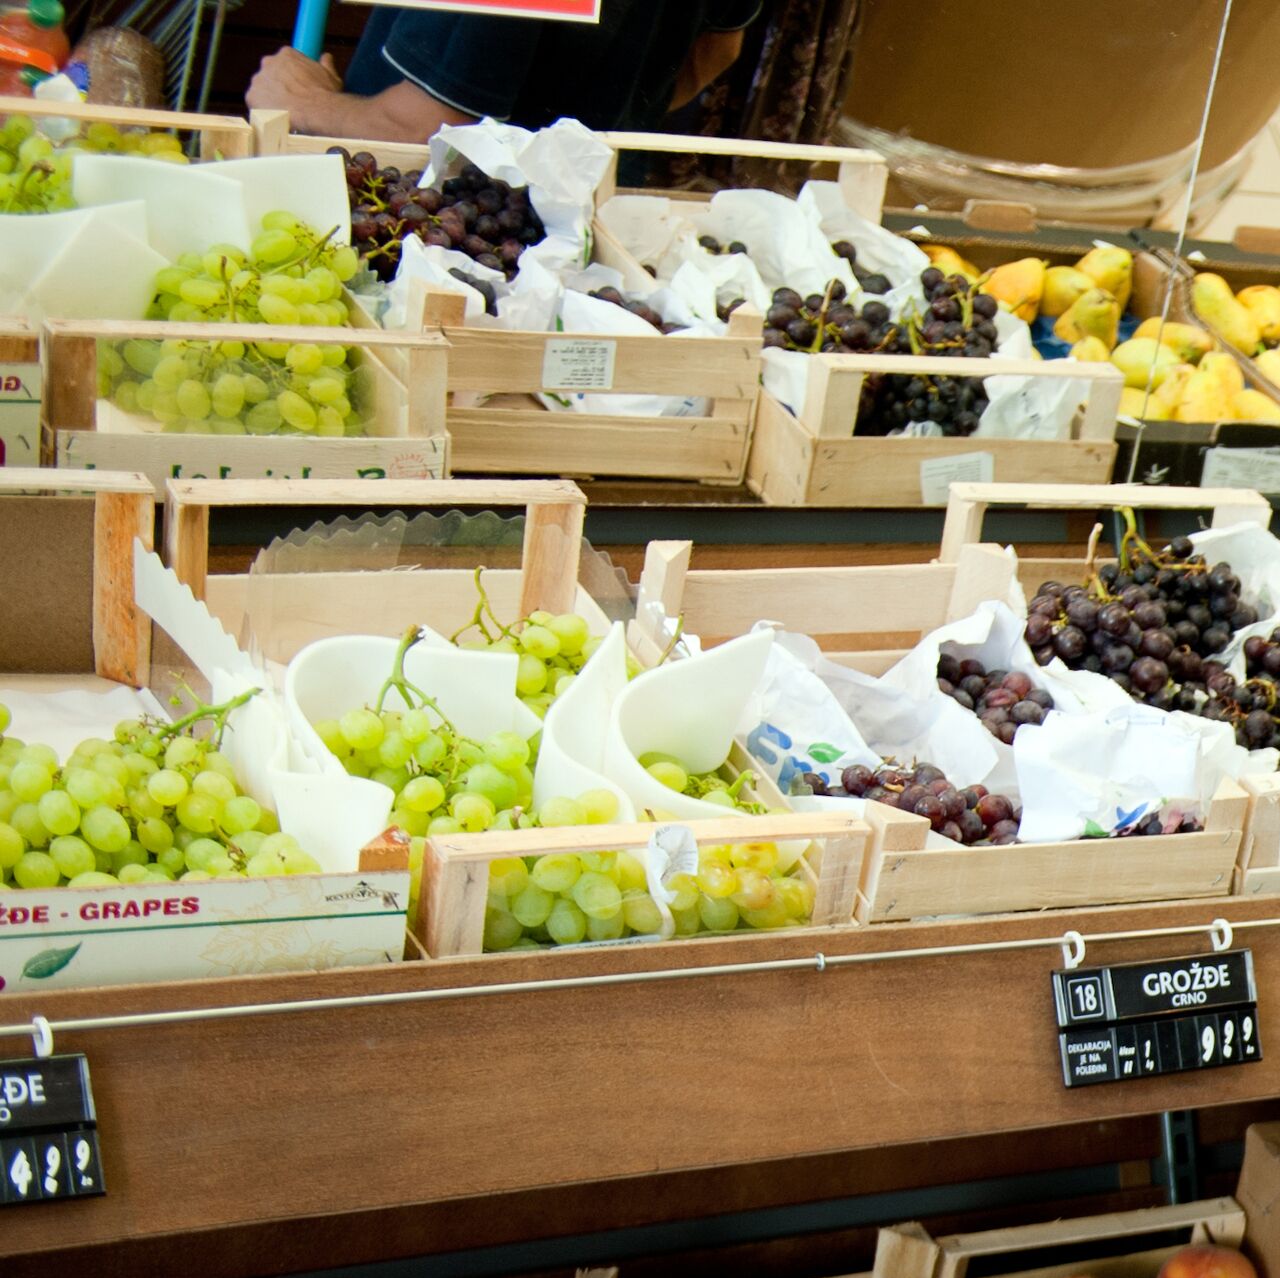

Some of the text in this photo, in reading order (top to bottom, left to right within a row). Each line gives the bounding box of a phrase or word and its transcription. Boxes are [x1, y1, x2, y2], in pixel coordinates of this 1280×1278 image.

[79, 896, 200, 921] GRAPES
[1142, 962, 1231, 996] GROŽĐE
[1074, 983, 1098, 1012] 18
[1171, 990, 1208, 1008] CRNO
[1067, 1039, 1112, 1055] DEKLARACIJA
